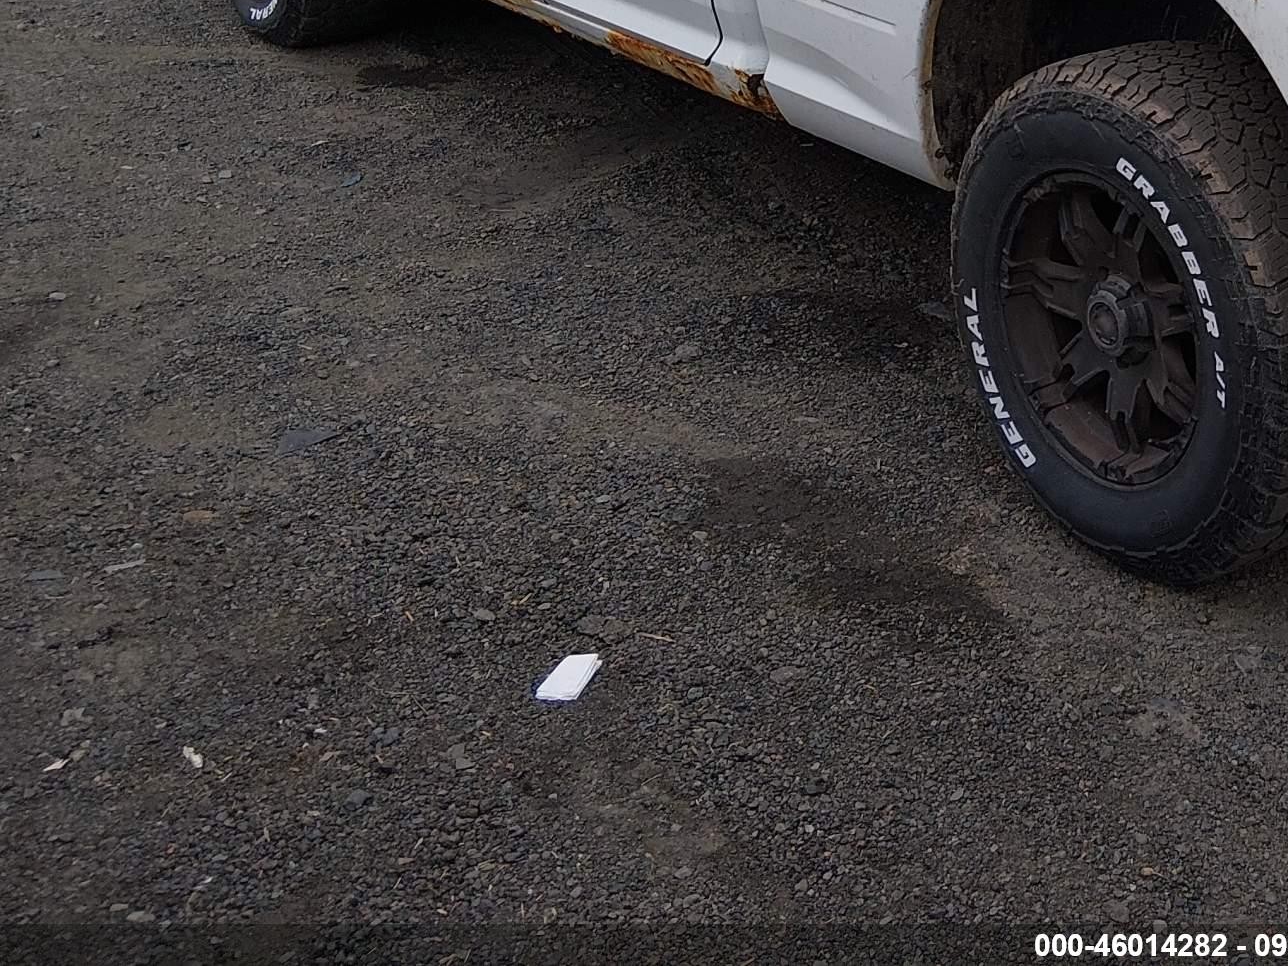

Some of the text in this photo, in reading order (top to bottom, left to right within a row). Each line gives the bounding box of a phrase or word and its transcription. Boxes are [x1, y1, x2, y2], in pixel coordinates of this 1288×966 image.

[963, 287, 1037, 469] GENERAL
[1116, 157, 1226, 409] GRABBER A/T
